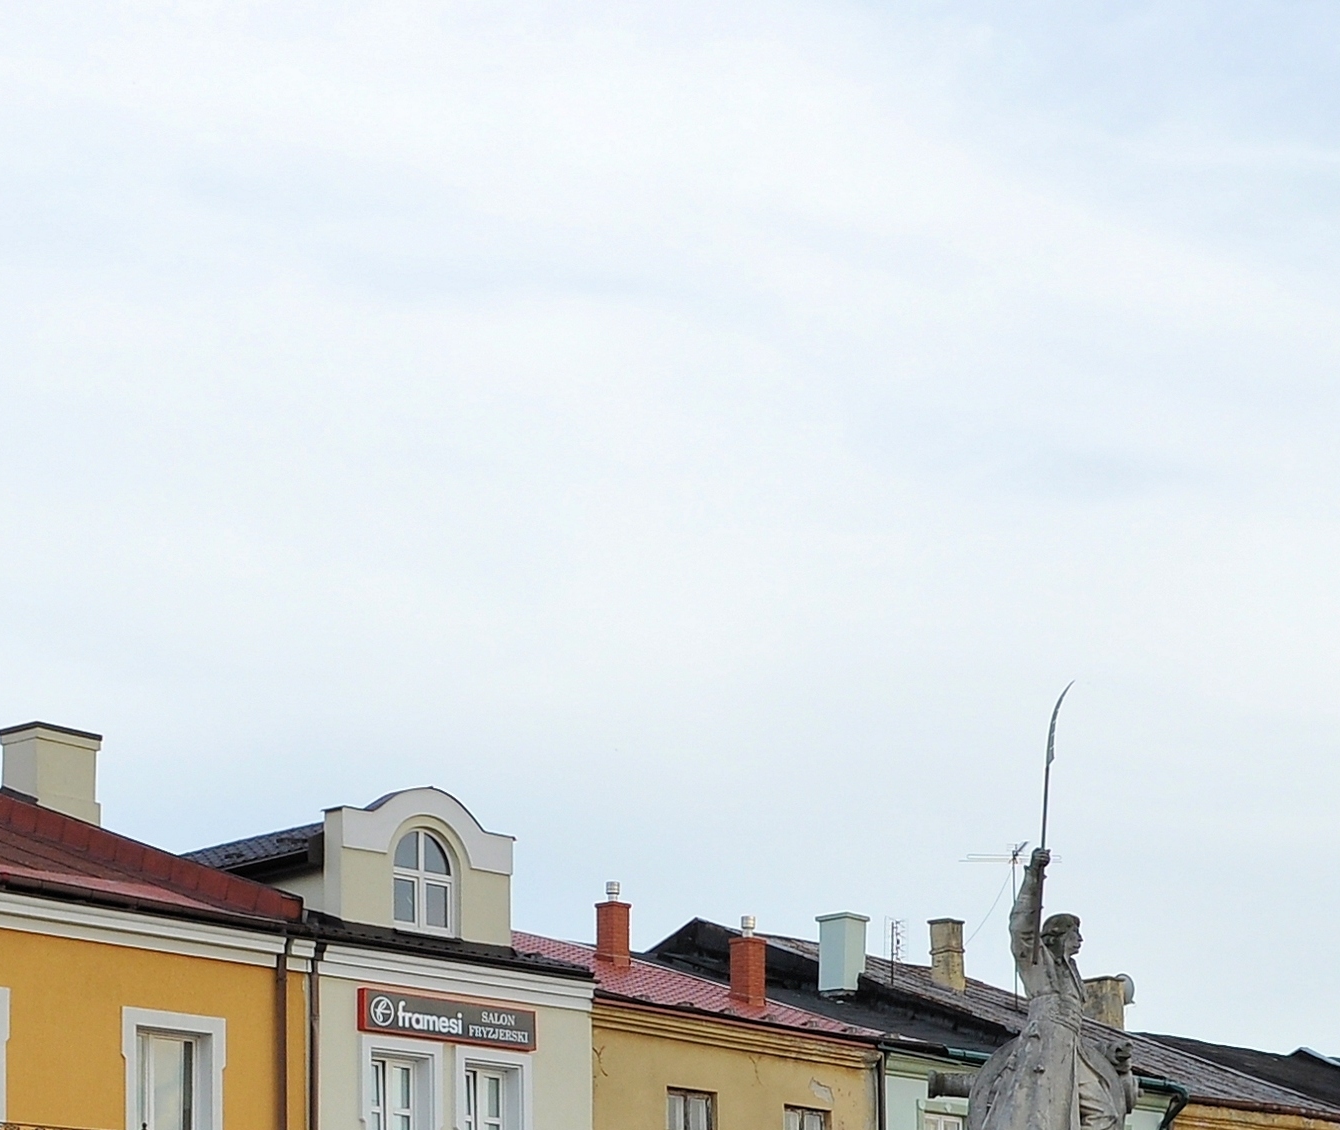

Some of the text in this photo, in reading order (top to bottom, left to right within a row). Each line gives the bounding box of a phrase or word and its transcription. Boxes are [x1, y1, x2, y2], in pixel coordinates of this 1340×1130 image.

[397, 1000, 463, 1035] framesi
[481, 1011, 516, 1026] SALON
[468, 1024, 529, 1044] FRYZJERSKI
